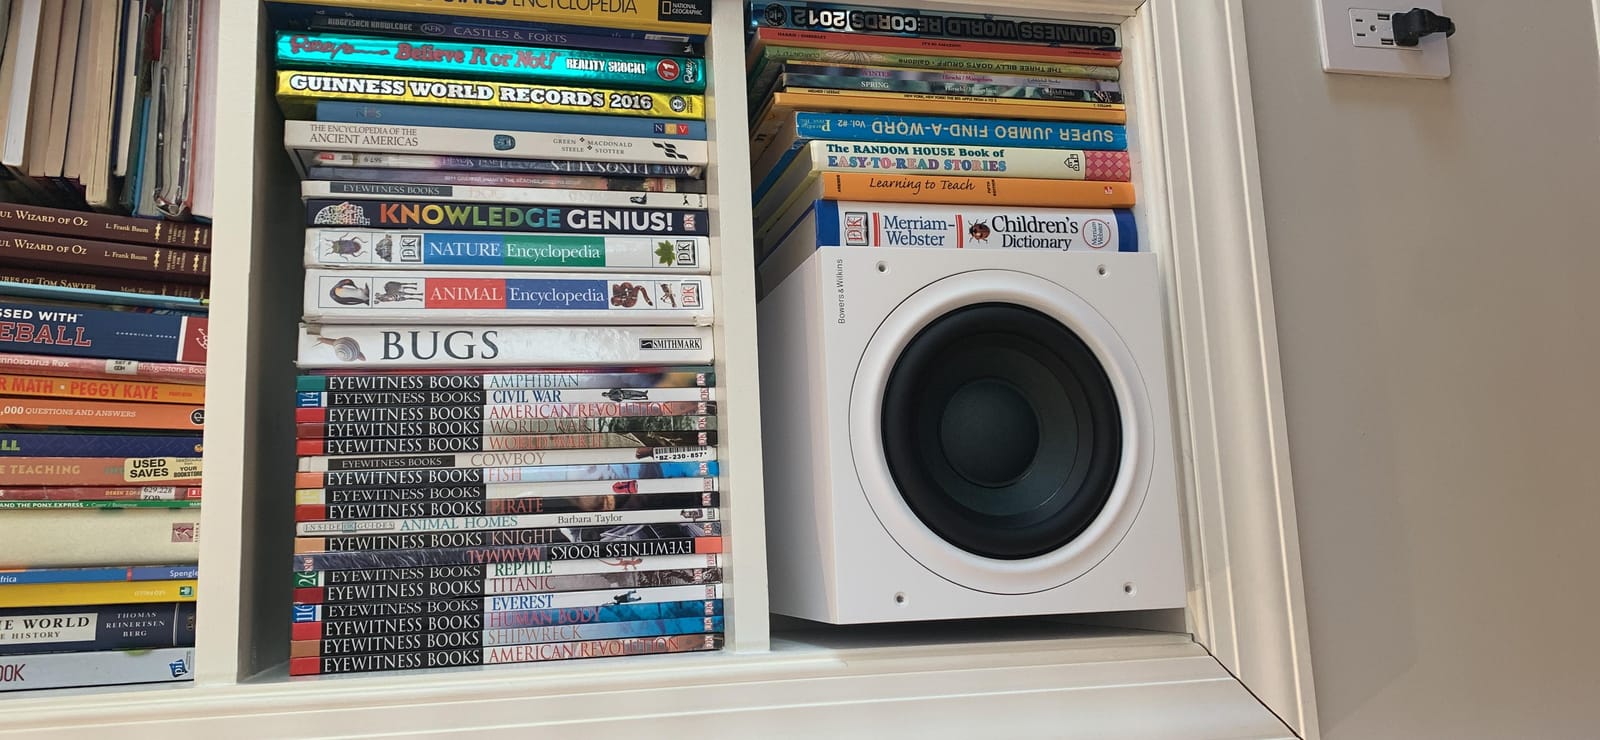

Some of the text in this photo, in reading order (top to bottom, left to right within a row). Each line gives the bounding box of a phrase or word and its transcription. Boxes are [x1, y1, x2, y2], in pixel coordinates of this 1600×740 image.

[794, 8, 846, 26] 2012
[852, 12, 942, 32] RECORDS
[454, 26, 568, 44] CASTLES & FORTS
[950, 18, 1015, 38] WORLD
[1021, 23, 1114, 44] GUINNESS
[394, 43, 560, 70] Believe It or Not!
[566, 58, 646, 74] REALITY SHOCK!
[290, 74, 652, 110] GUINNESS WORLD RECORDS 2016
[860, 80, 889, 88] SPRING
[310, 124, 326, 132] THE
[327, 125, 388, 135] ENCYCLOPEDIA
[401, 128, 417, 136] THE
[838, 119, 849, 128] #2
[852, 120, 866, 128] Vol.
[872, 120, 988, 138] FIND-A-WORD
[309, 133, 418, 146] ANCIENT AMERICAS
[994, 125, 1053, 140] JUMBO
[1060, 128, 1114, 143] SUPER
[826, 144, 1004, 157] The RANDOM HOUSE Book of
[828, 156, 1006, 172] EASY-TO-READ STORIES
[343, 184, 440, 195] EYEWITNESS BOOKS
[870, 178, 976, 195] Learning to Teach
[380, 203, 673, 232] KNOWLEDGE GENIUS!
[883, 215, 956, 230] Merriam-
[992, 215, 1079, 234] Children's
[113, 224, 130, 232] Frank
[886, 230, 945, 246] Webster
[1002, 234, 1072, 251] Dictionary
[429, 242, 600, 262] NATURE Encyclopedia
[60, 280, 96, 290] SAWYER
[430, 287, 604, 306] ANIMAL Encyclopedia
[38, 311, 77, 323] WITH
[838, 294, 846, 324] Bowers
[380, 330, 500, 360] BUGS
[652, 339, 700, 349] SMITHMARK
[12, 376, 54, 394] MATH
[70, 381, 119, 398] PEGGY
[123, 384, 159, 400] KAYE
[329, 374, 579, 390] EYEWITNESS BOOKS AMPHIBIAN
[334, 390, 562, 404] EYEWITNESS BOOKS CIVIL WAR
[25, 408, 74, 416] QUESTIONS
[94, 410, 136, 418] ANSWERS
[329, 402, 674, 422] EYEWITNESS BOOKS AMERICAN REVOLUTION
[328, 418, 587, 437] EYEWITNESS BOOKS WORLD WAR
[327, 435, 586, 453] EYEWITNESS BOOKS WORLD WAR
[133, 458, 166, 468] USED
[342, 452, 546, 469] EYEWITNESS BOOKS COWBOY
[10, 465, 80, 475] TEACHING
[130, 468, 168, 478] SAVES
[327, 469, 522, 486] EYEWITNESS BOOKS FISH
[333, 486, 480, 502] EYEWITNESS BOOKS
[330, 496, 544, 518] EYEWITNESS BOOKS PIRATE
[400, 514, 624, 531] ANIMAL HOMES Barbara Taylor
[330, 528, 554, 552] EYEWITNESS BOOKS KNIGHT
[466, 540, 692, 564] EYEWITNESS BOOKS MAMMAL
[331, 566, 480, 583] EYEWITNESS BOOKS
[328, 576, 556, 601] EYEWITNESS BOOKS TITANIC
[328, 594, 554, 618] EYEWITNESS BOOKS EVEREST
[23, 616, 90, 629] WORLD
[105, 620, 165, 629] REINERTSEN
[326, 608, 600, 636] EYEWITNESS BOOKS HUMAN BODY
[12, 631, 60, 639] HISTORY
[324, 626, 582, 654] EYEWITNESS BOOKS SHIPWRECK
[324, 638, 679, 672] EYEWITNESS BOOKS AMERICAN REVOLUTION
